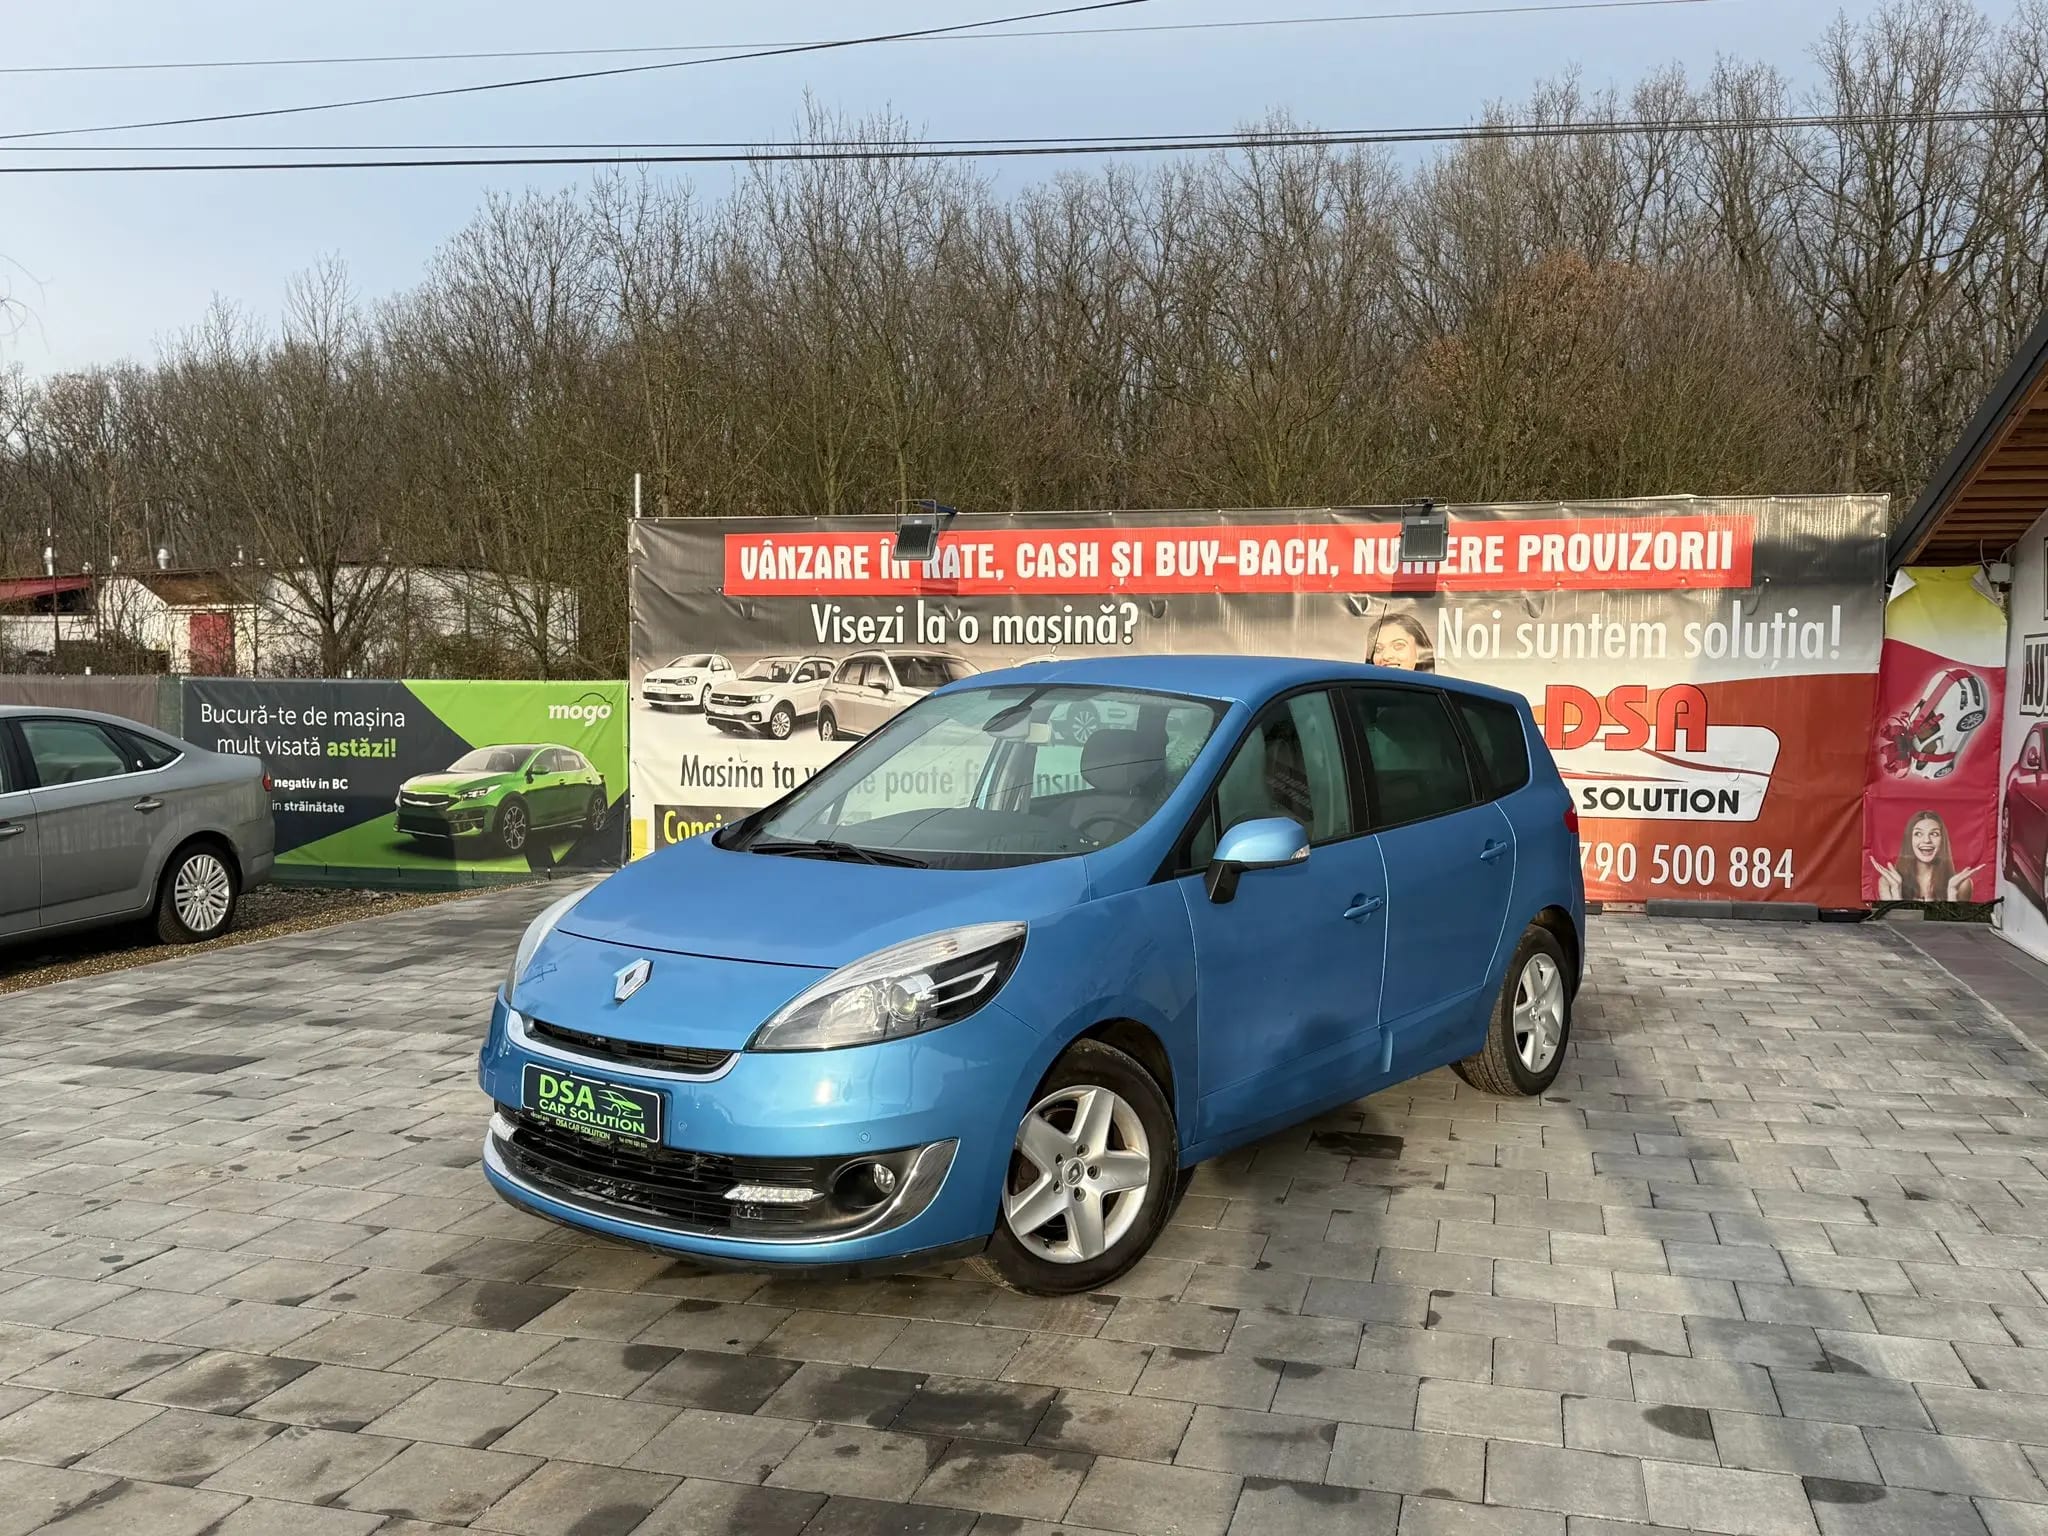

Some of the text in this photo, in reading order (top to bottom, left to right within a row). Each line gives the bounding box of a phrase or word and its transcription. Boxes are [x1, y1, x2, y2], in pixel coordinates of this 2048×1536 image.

[740, 540, 869, 580] VÂNZARE
[922, 543, 1004, 581] RATE,
[1016, 541, 1099, 578] CASH
[1111, 541, 1143, 586] ȘI
[1156, 537, 1338, 578] BUY-BACK,
[1518, 531, 1733, 573] PROVIZORII
[810, 599, 1139, 653] Visezi la o mașină?
[1437, 600, 1841, 670] Noi suntem soluția!
[2023, 644, 2048, 707] AU
[201, 703, 406, 731] Bucură-te de mașina
[548, 704, 612, 727] mogo
[1544, 684, 1708, 752] DSA
[217, 735, 397, 758] mult visată astăzi!
[274, 778, 317, 790] negativ
[332, 778, 349, 790] BC
[680, 754, 763, 788] Masina
[772, 761, 795, 789] ta
[283, 800, 345, 813] străinătate
[1582, 786, 1740, 815] SOLUTION
[1650, 844, 1716, 886] 500
[1728, 846, 1794, 889] 884
[539, 1073, 596, 1110] DSA
[539, 1098, 566, 1116] CAR
[569, 1107, 645, 1134] SOLUTION
